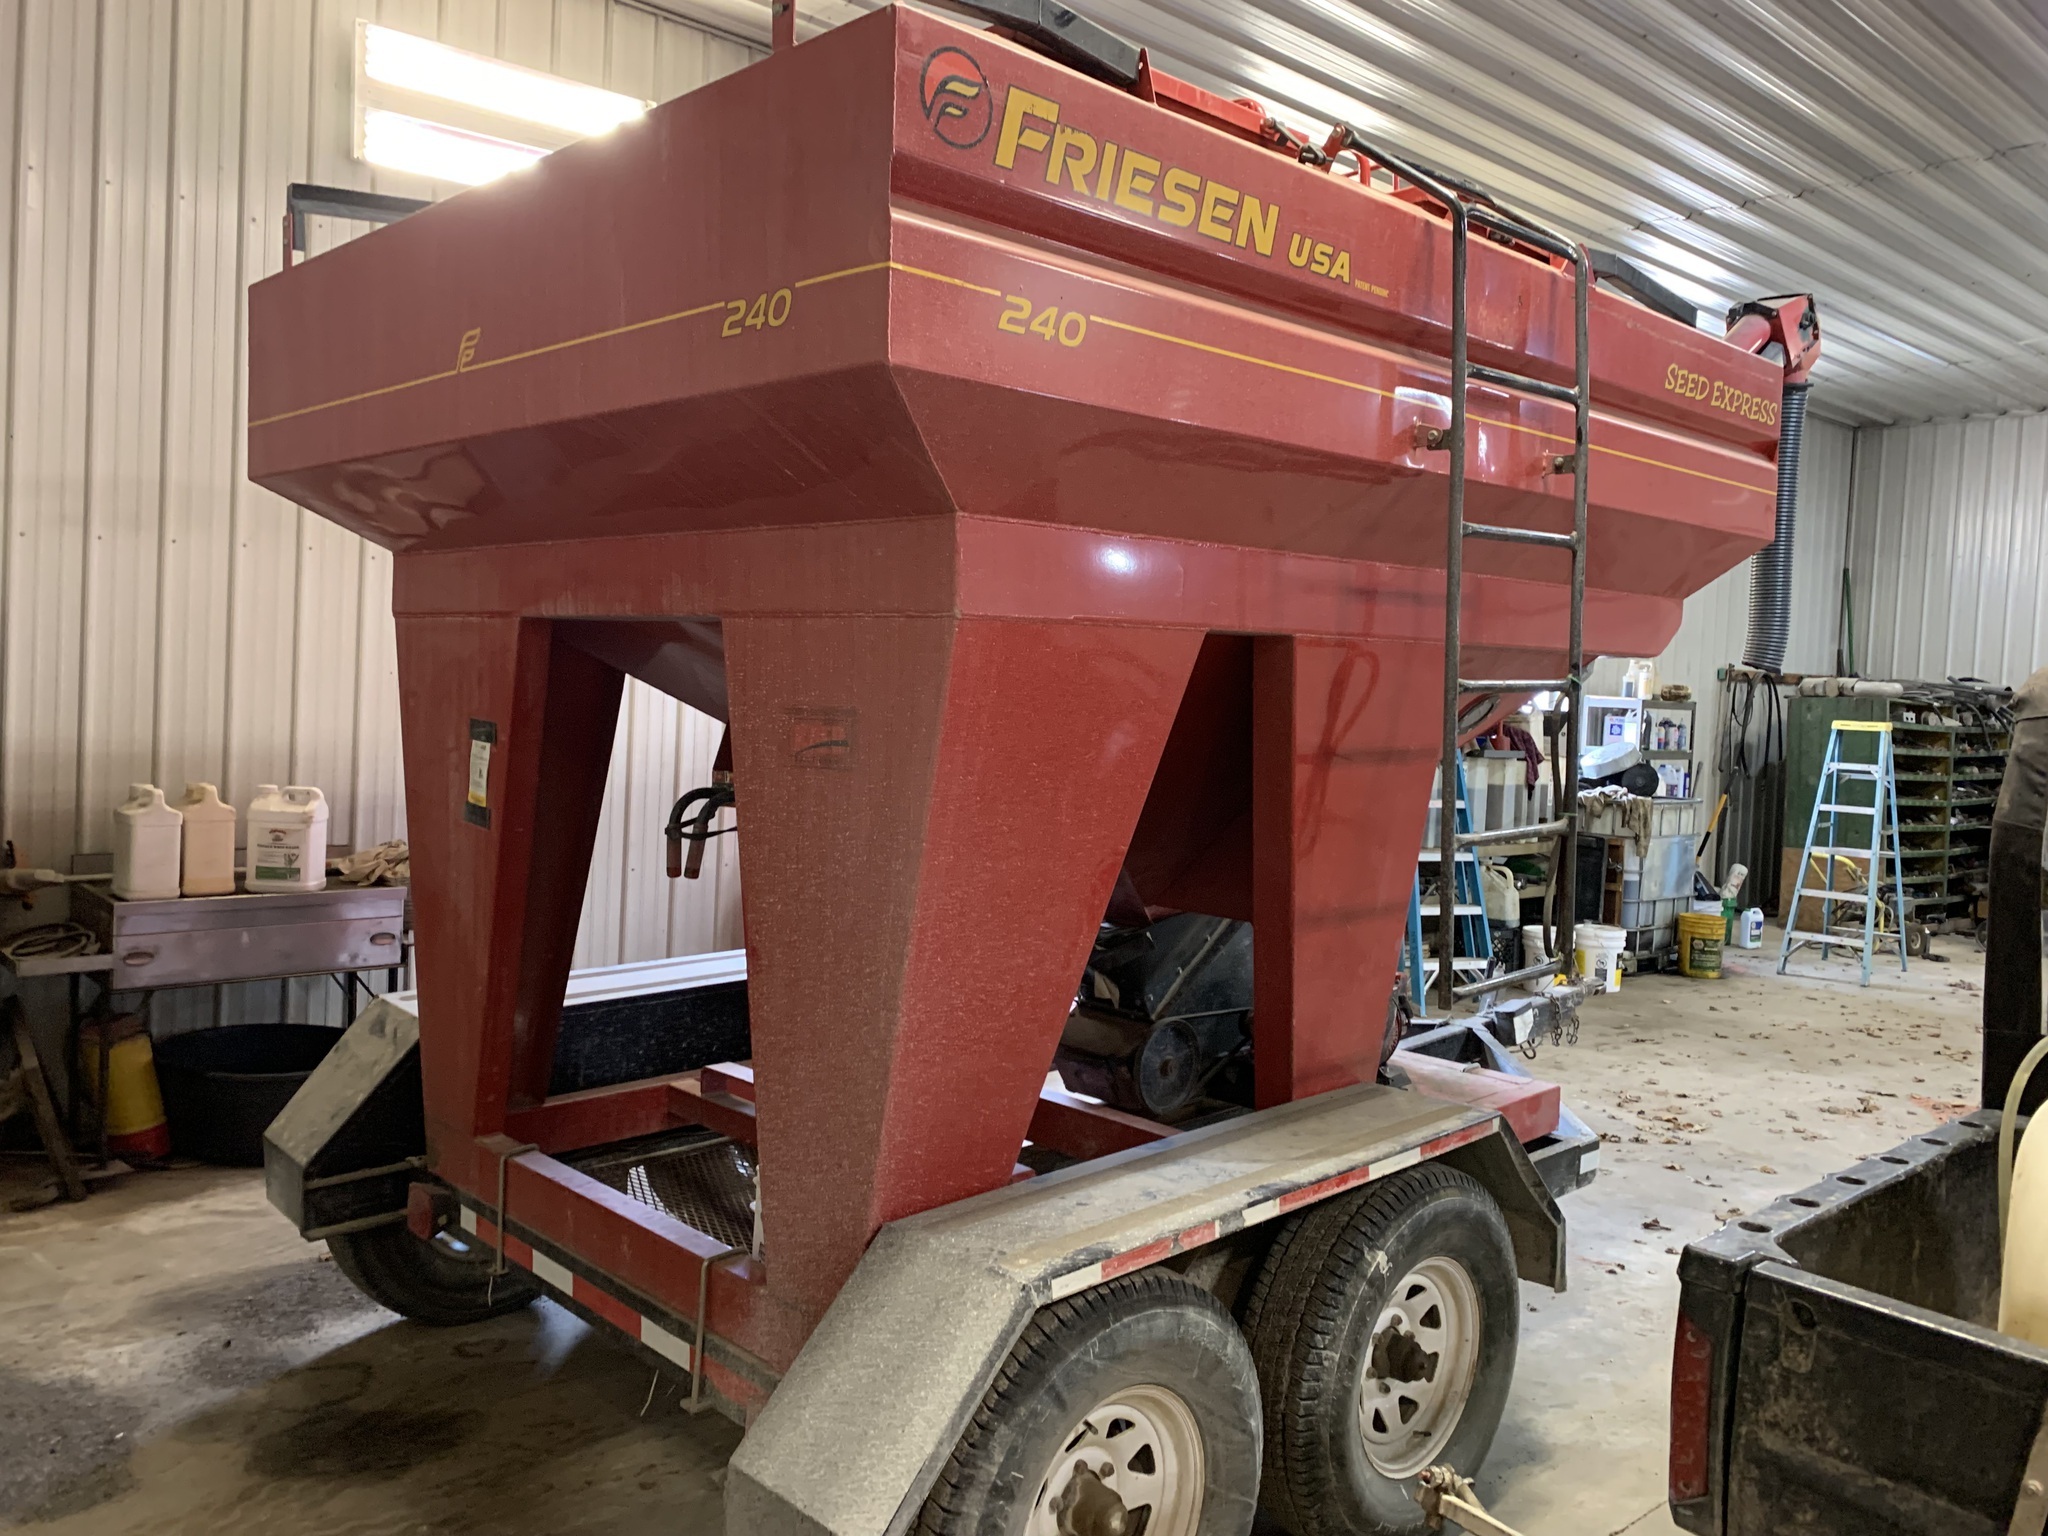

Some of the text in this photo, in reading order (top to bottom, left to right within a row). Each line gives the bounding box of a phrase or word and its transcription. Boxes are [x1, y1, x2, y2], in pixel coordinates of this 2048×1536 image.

[994, 85, 1351, 284] FRIESEN USA
[721, 287, 793, 338] 240
[997, 294, 1087, 348] 240
[1664, 362, 1778, 426] SEED EXPRESS
